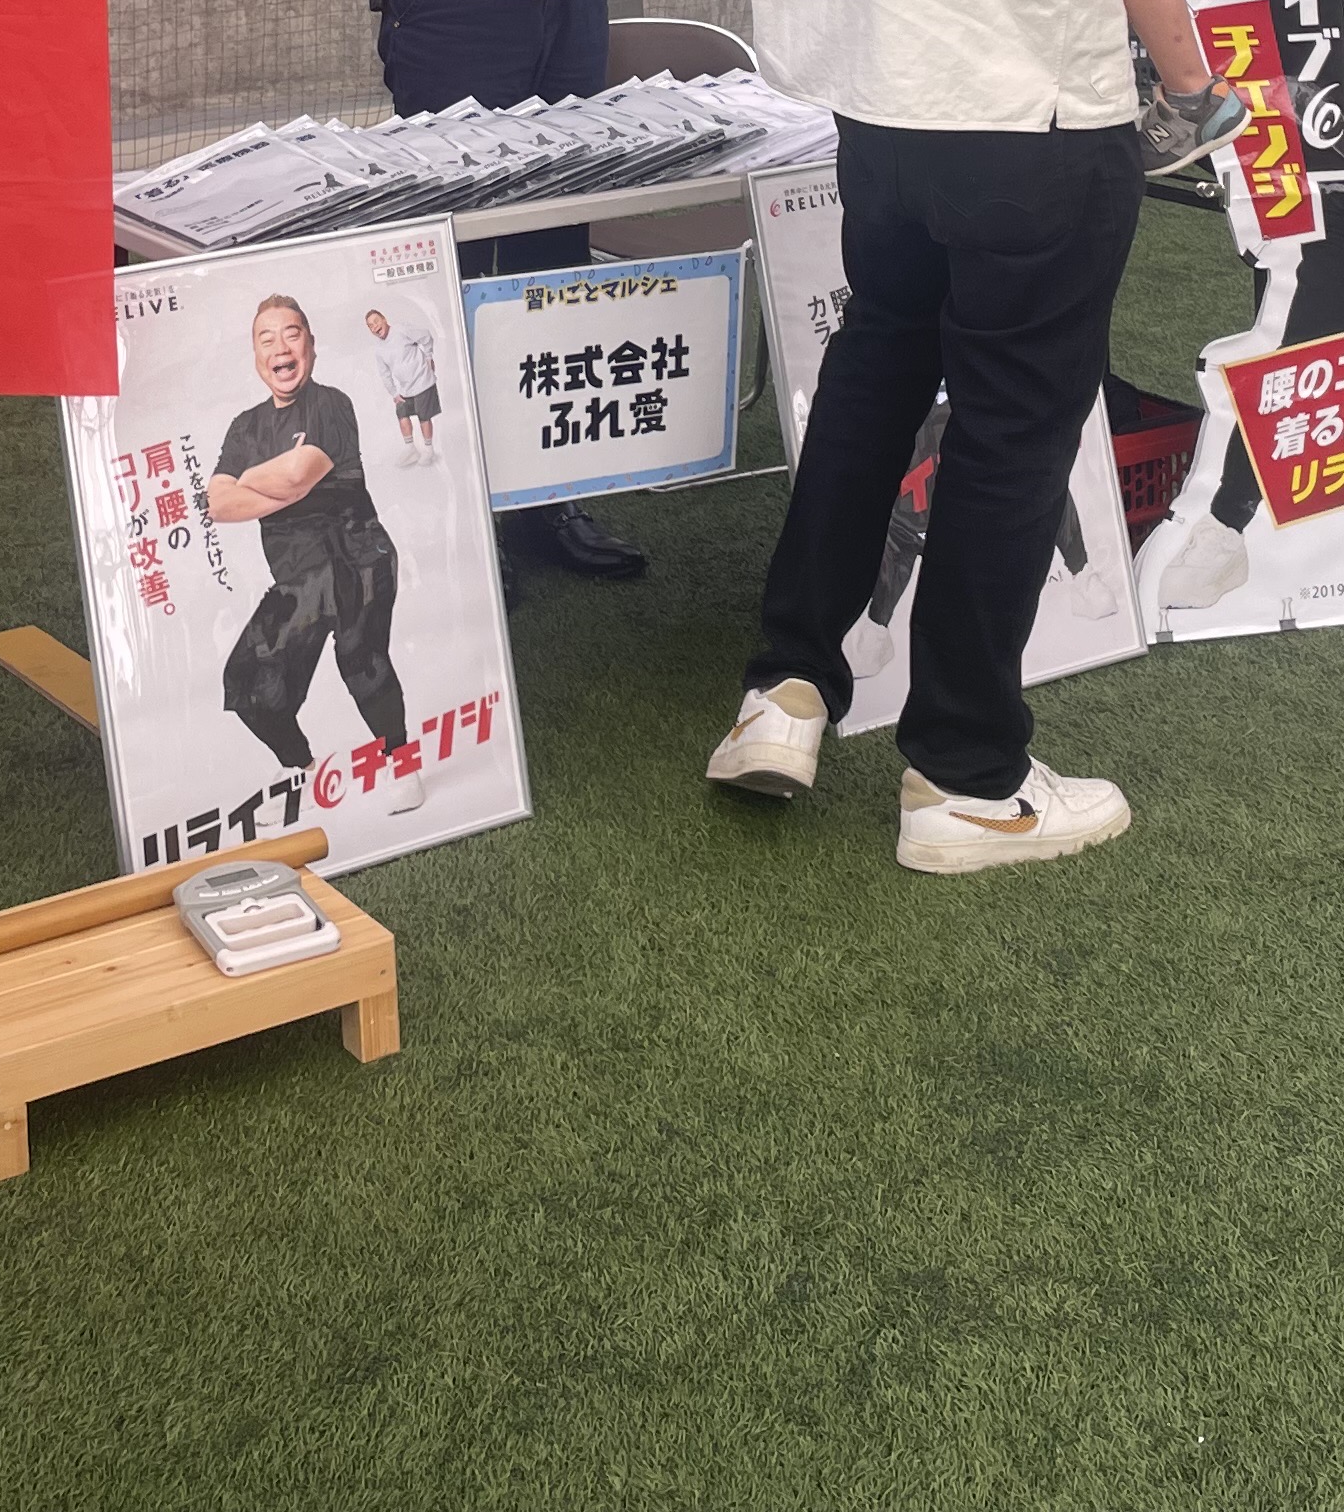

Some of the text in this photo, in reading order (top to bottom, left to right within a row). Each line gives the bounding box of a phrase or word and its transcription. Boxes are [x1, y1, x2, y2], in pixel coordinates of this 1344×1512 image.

[376, 261, 435, 278] 一般医療機器
[525, 275, 677, 311] 習いごとマルシェ
[519, 334, 689, 399] 株式会社
[541, 388, 668, 449] ふれ愛
[111, 452, 176, 616] コリが改善。
[141, 440, 191, 550] 肩・腰の
[179, 433, 233, 592] これを着るだけで、
[351, 691, 500, 794] チェンジ
